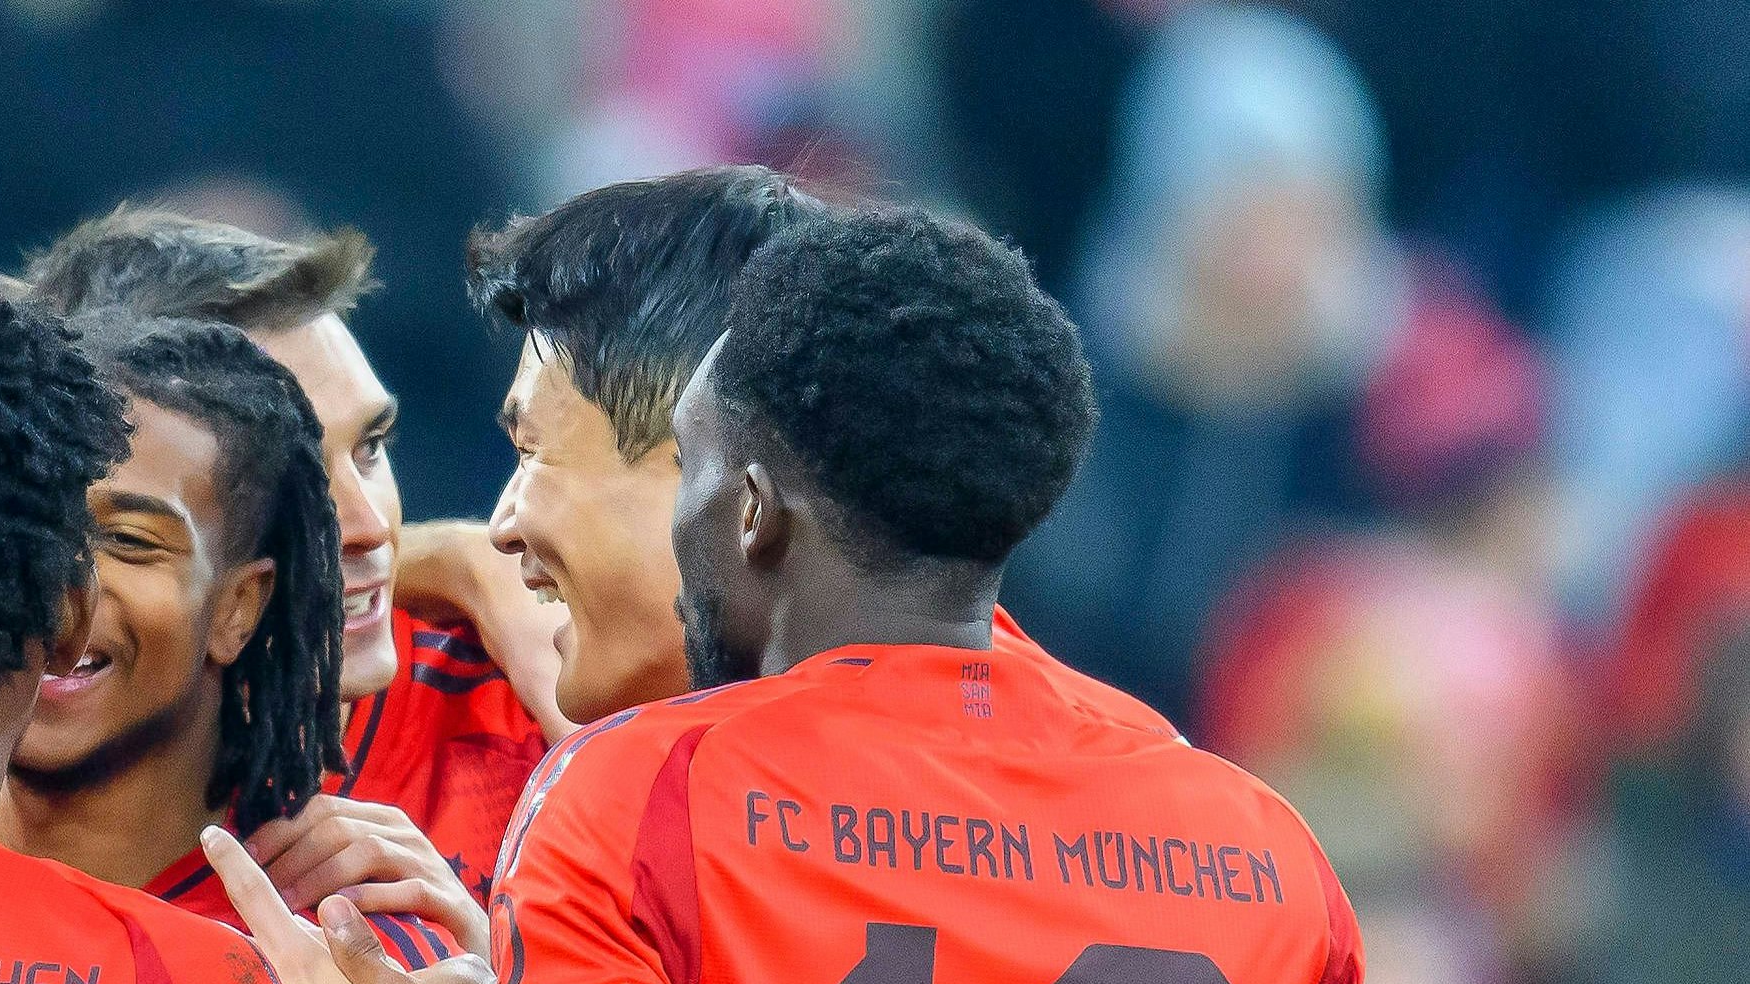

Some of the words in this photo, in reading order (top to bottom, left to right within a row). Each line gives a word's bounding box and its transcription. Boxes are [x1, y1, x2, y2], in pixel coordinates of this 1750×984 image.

[961, 662, 989, 681] MIA
[961, 682, 989, 699] SAN
[746, 790, 810, 852] FC
[830, 803, 1034, 881] BAYERN
[1053, 830, 1284, 904] MÜNCHEN
